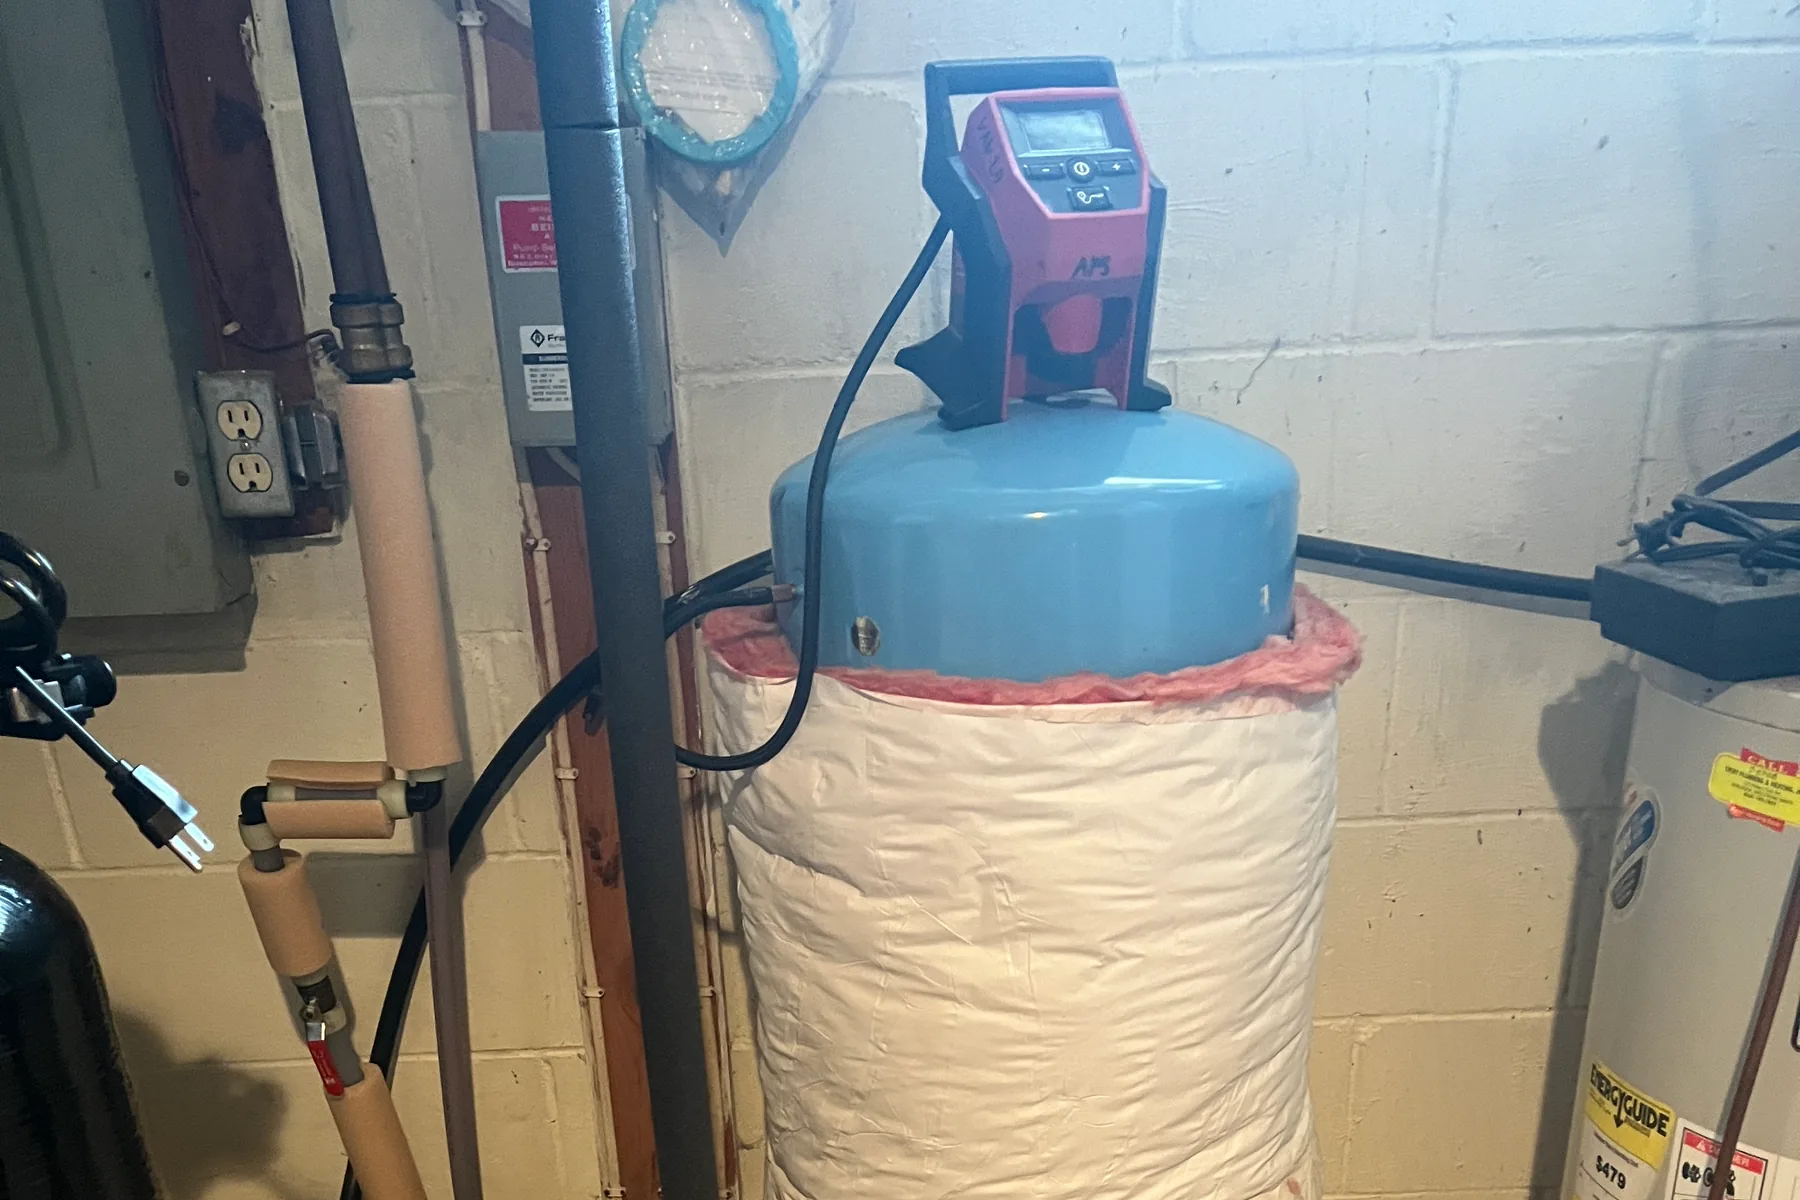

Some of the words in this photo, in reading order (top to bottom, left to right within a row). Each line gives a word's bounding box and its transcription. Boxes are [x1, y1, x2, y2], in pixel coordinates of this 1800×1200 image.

[547, 333, 566, 342] Fra
[1747, 755, 1788, 774] CALL
[1596, 1155, 1627, 1189] $479
